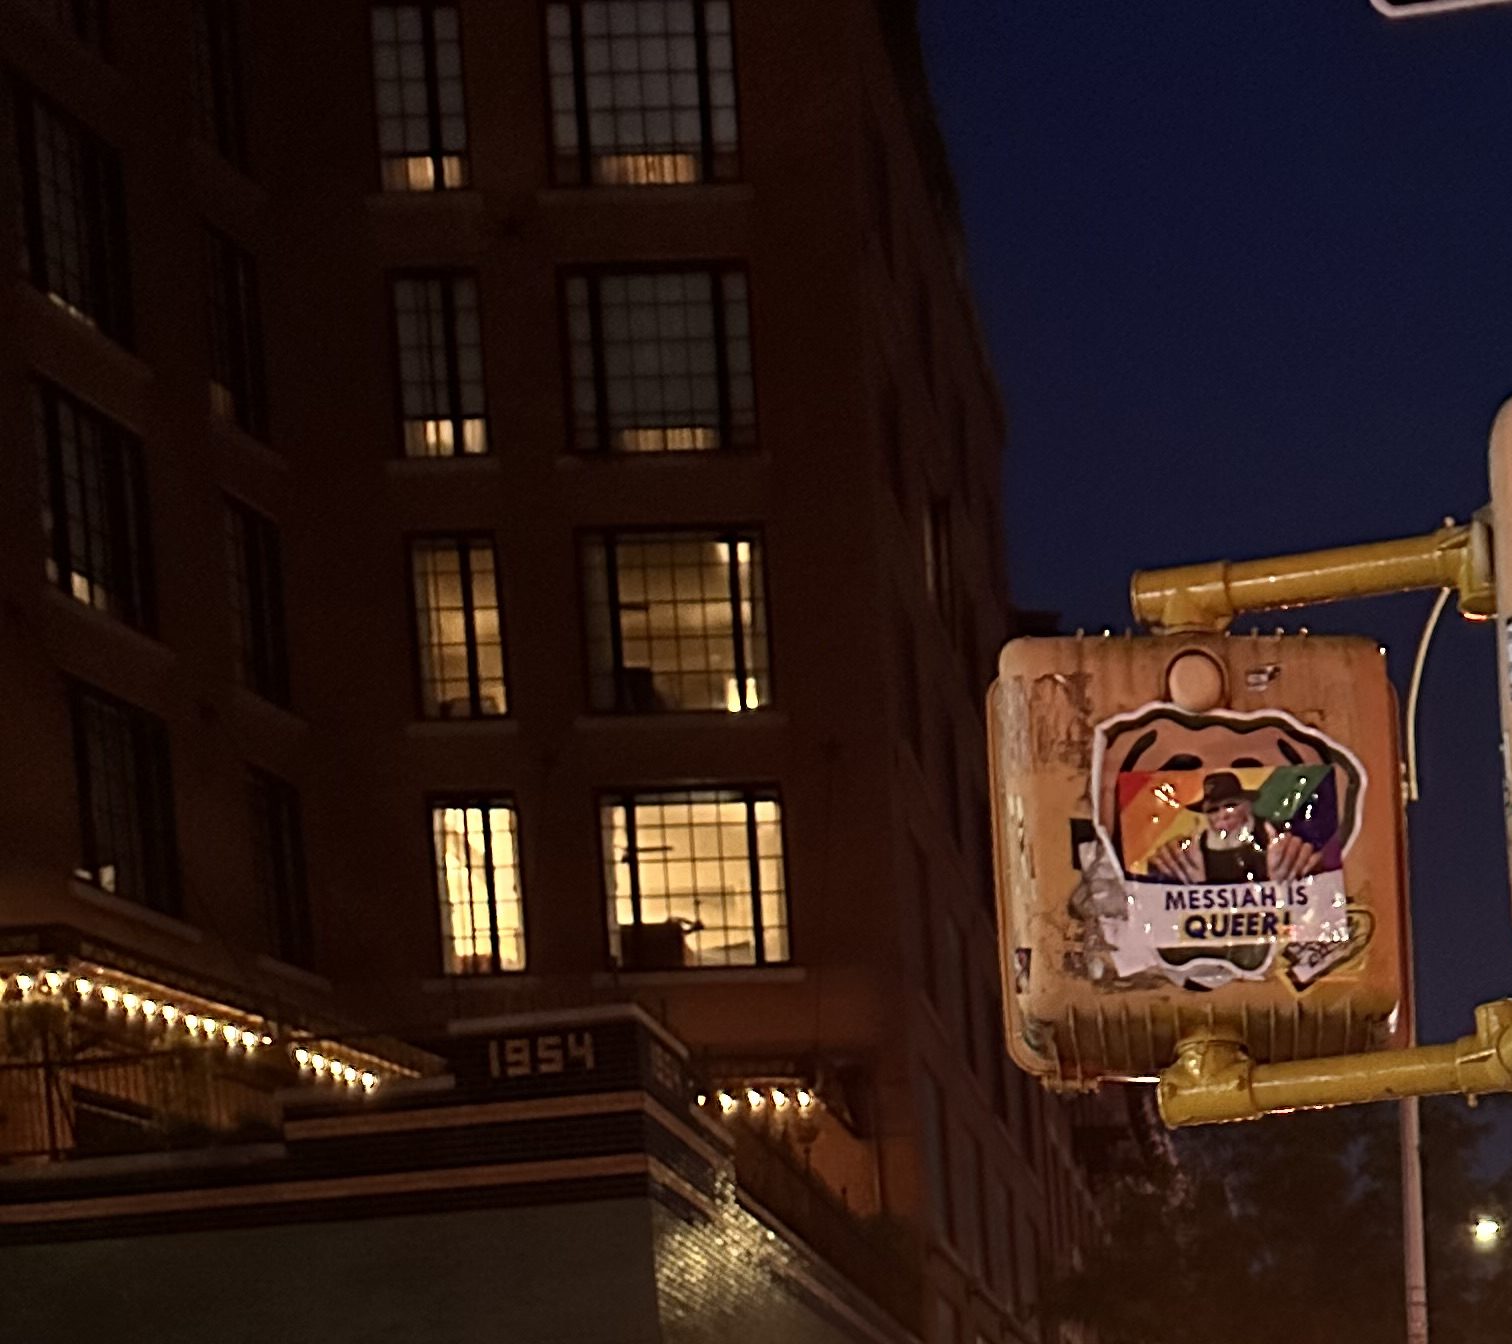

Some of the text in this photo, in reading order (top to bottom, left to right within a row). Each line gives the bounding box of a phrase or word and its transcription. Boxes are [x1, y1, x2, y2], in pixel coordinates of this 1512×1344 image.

[1165, 884, 1309, 911] MESSIAH IS
[1184, 911, 1293, 938] QUEER!
[488, 1031, 595, 1079] 1954
